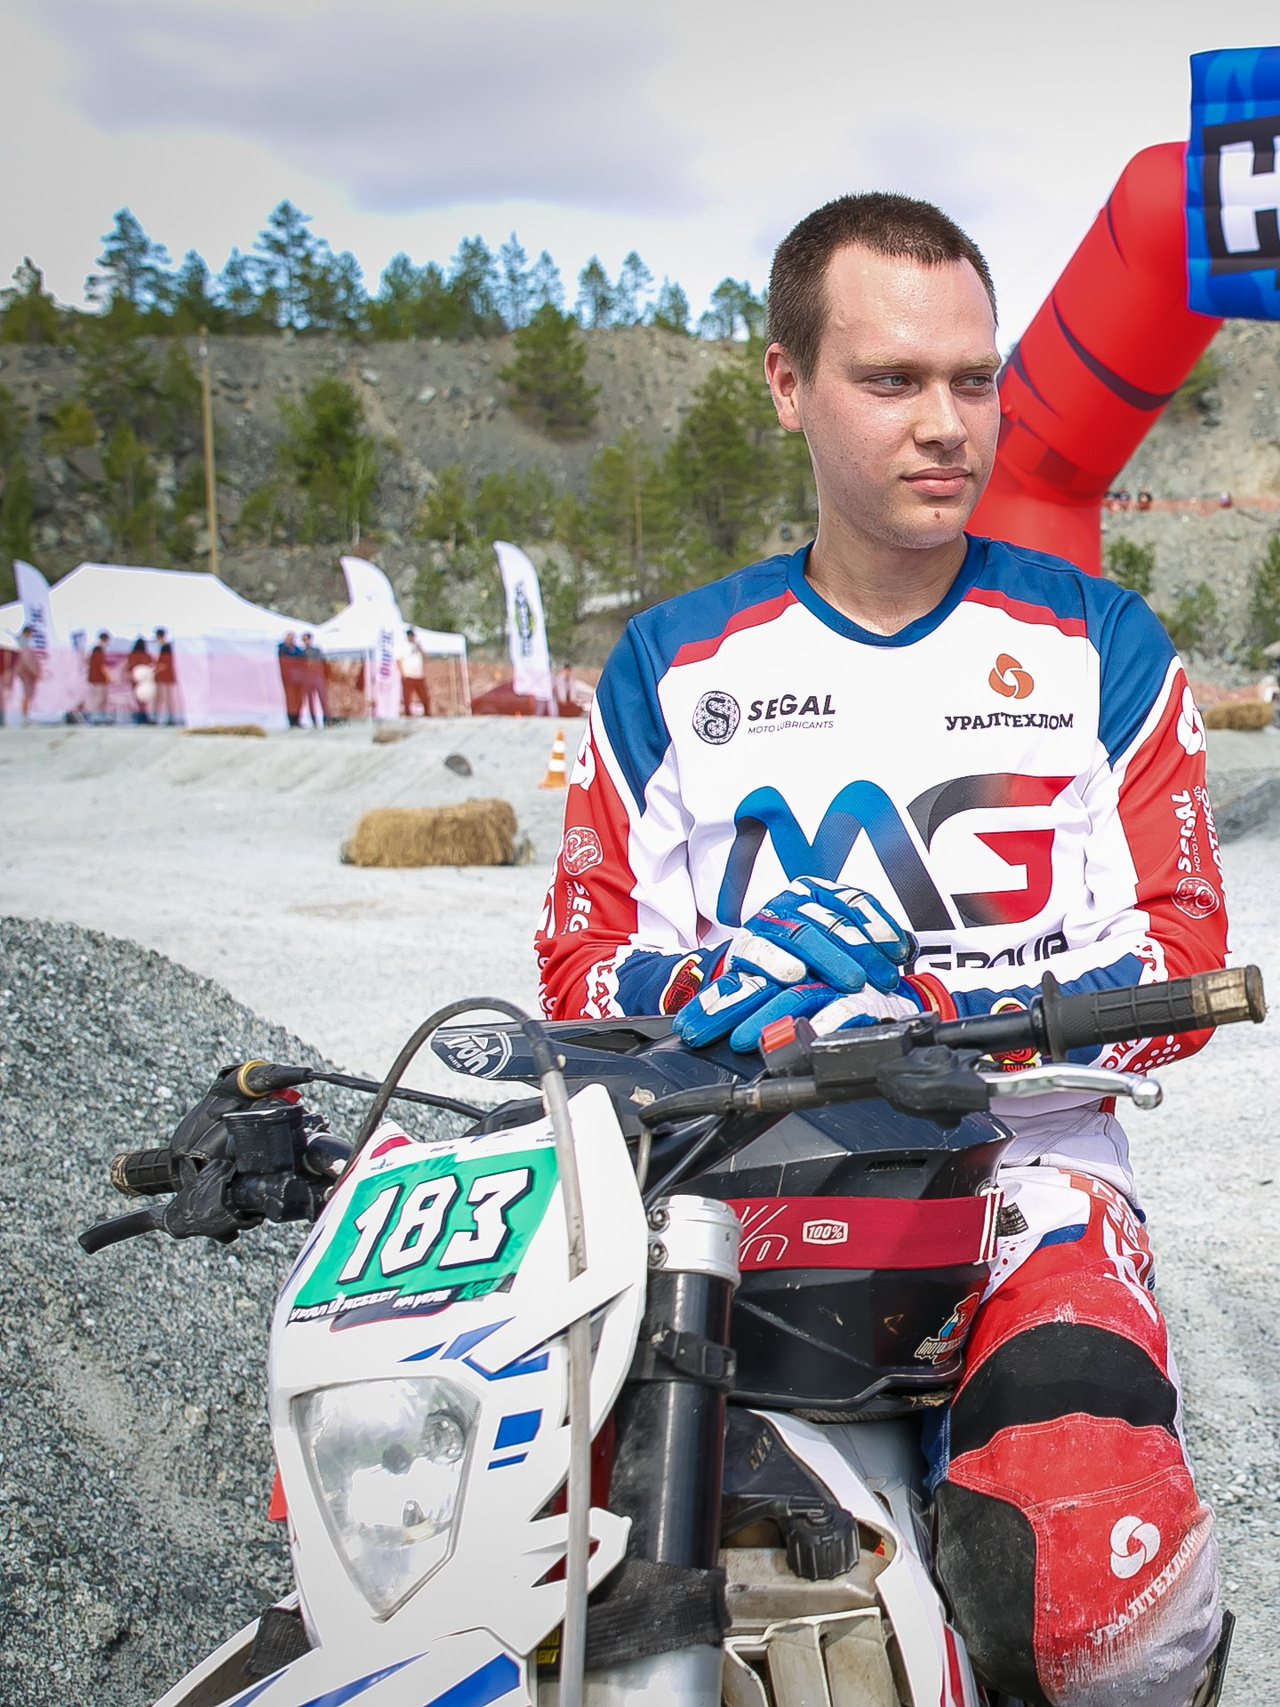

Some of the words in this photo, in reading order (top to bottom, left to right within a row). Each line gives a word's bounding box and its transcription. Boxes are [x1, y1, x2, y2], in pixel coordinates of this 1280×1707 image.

[747, 694, 836, 721] SEGAL
[748, 725, 775, 735] MOTO
[777, 720, 834, 732] LUBRICANTS
[944, 712, 1074, 731] УРАЛТЕХЛОМ
[568, 880, 592, 933] SEG
[339, 1168, 534, 1286] 183
[808, 1224, 843, 1239] 100%
